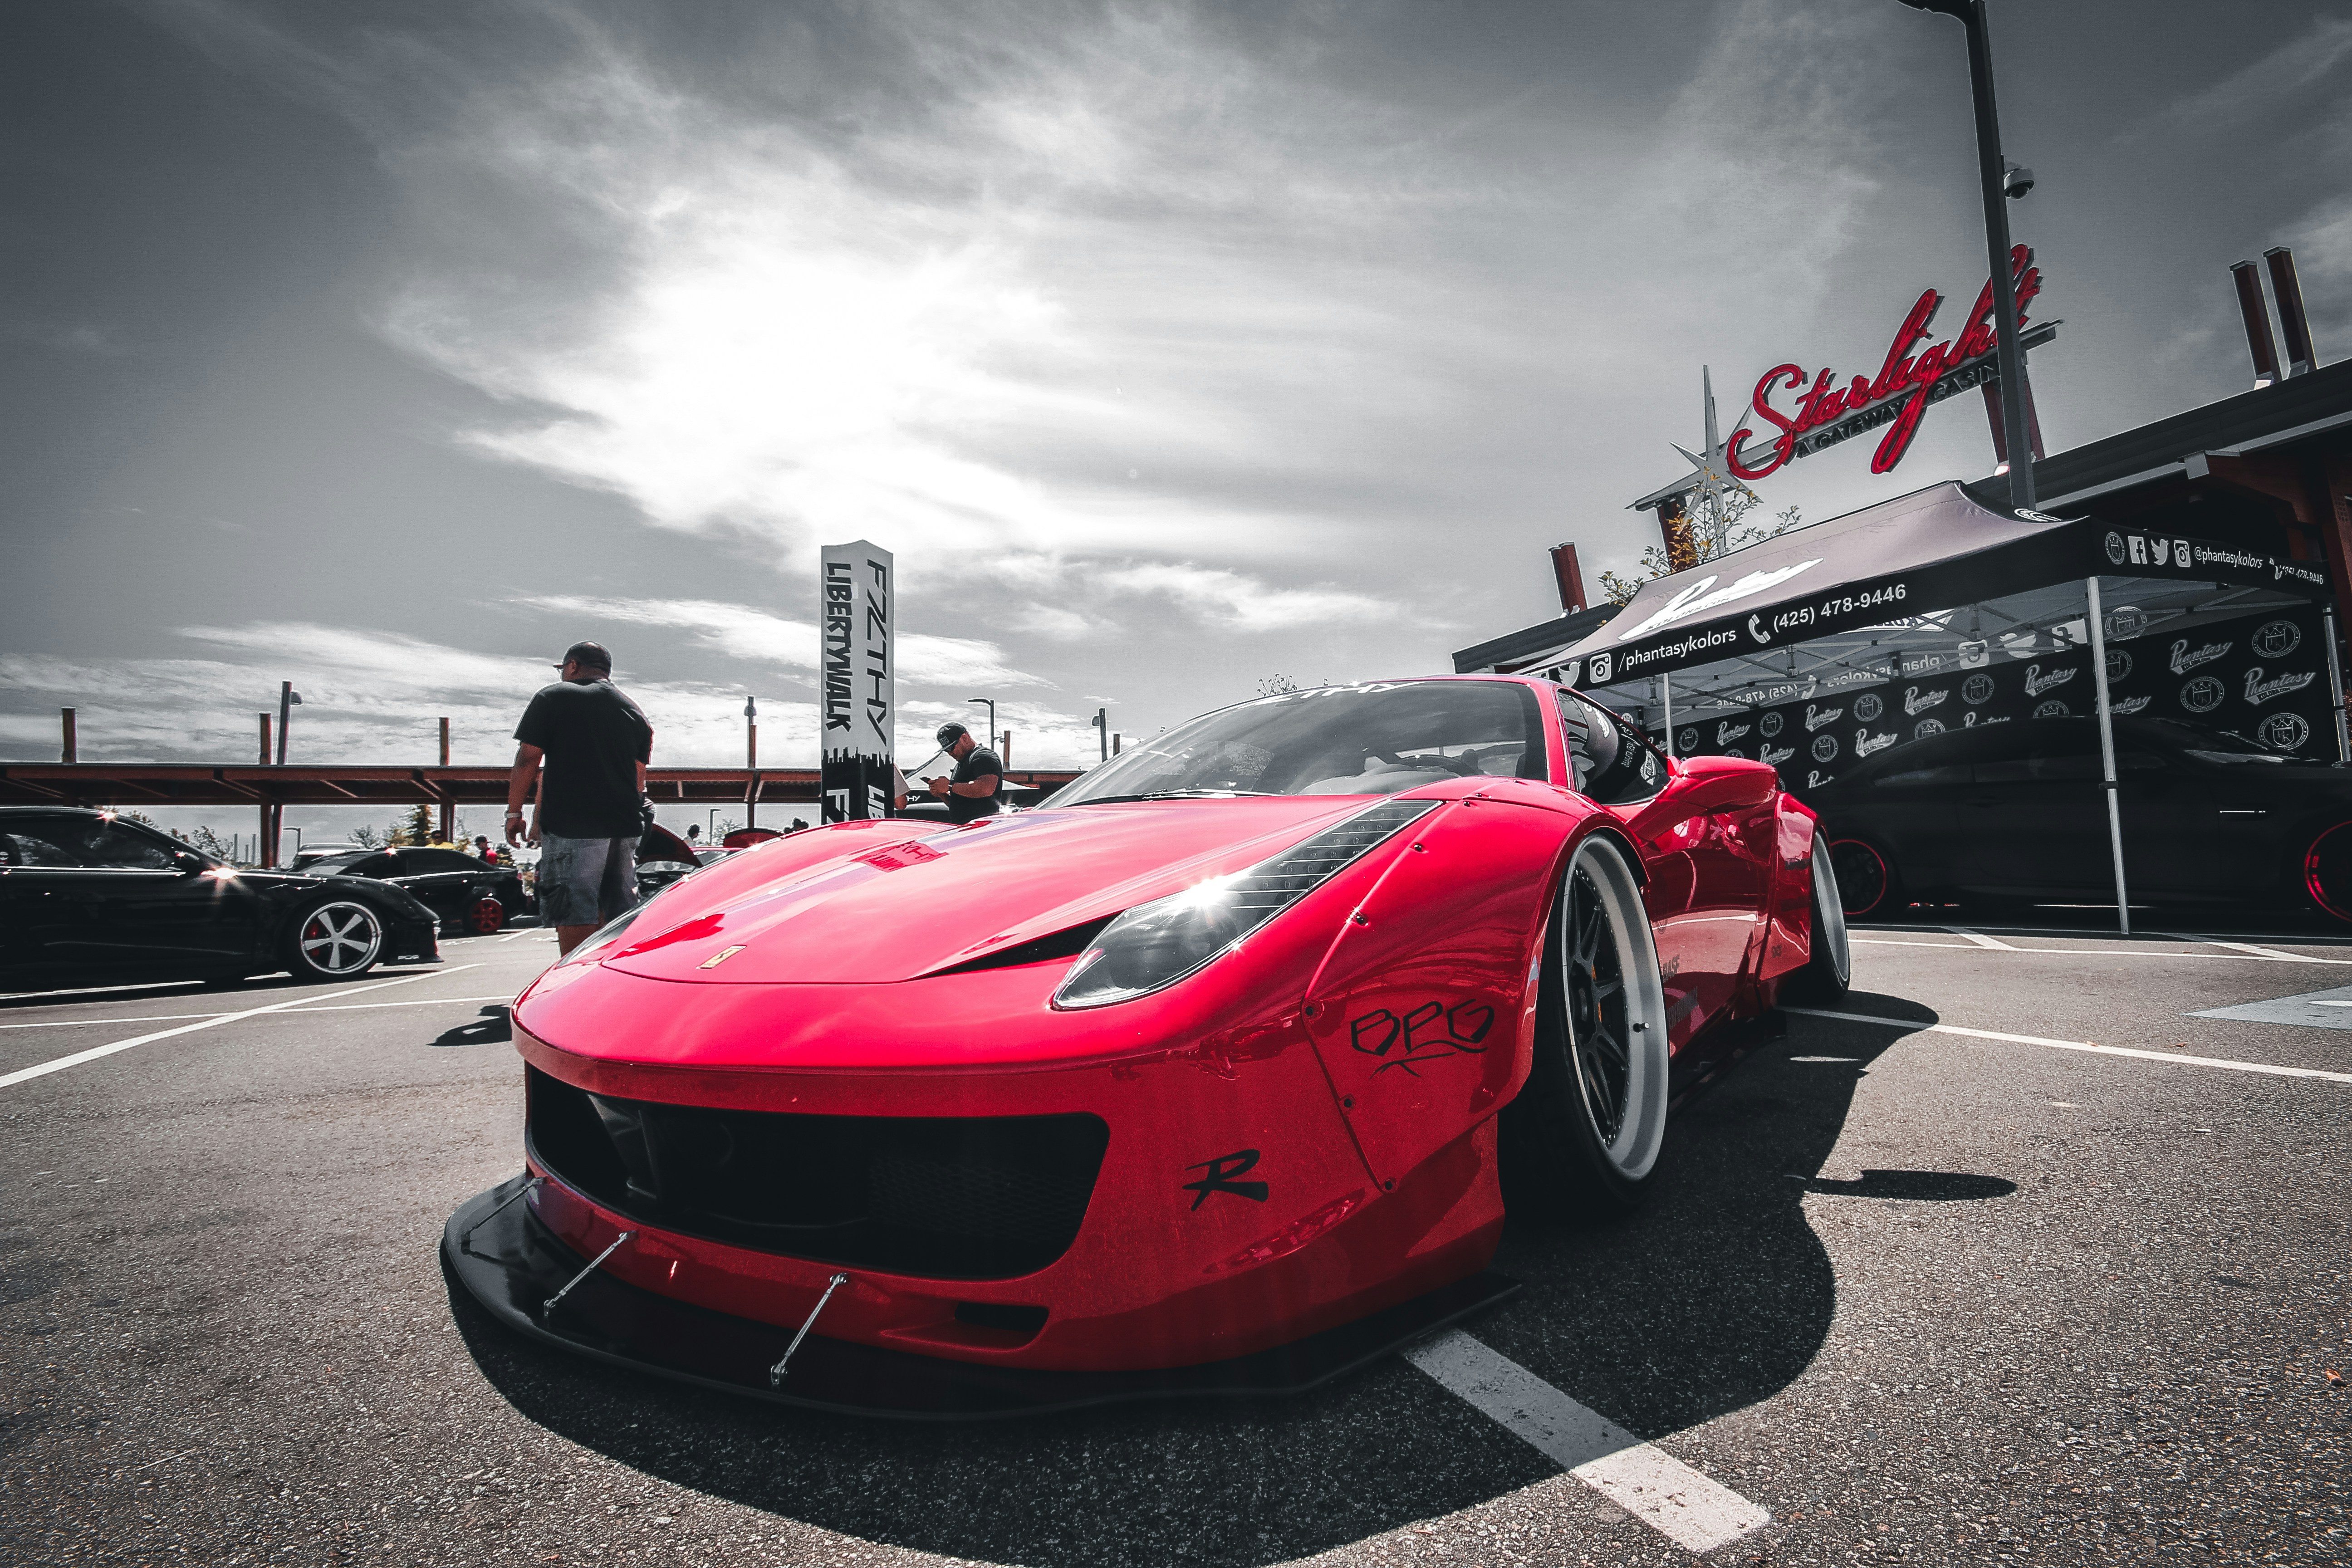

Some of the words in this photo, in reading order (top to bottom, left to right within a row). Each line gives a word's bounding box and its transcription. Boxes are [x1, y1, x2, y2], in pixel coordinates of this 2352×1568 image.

[1727, 243, 2042, 480] Starlight
[1929, 364, 2000, 400] CASIN
[2194, 547, 2263, 568] @phantasykolors
[1618, 630, 1737, 672] /phantasykolors
[1774, 606, 1815, 632] (425)
[1821, 583, 1906, 617] 478-9446
[826, 563, 853, 732] LIBERTYWALK
[867, 559, 887, 746] FZTHY
[2170, 639, 2234, 669] Phantasy
[2025, 664, 2078, 691] Phantasy
[2244, 667, 2316, 698] Phantasy
[1905, 686, 1949, 711] Phantasy
[1805, 705, 1843, 727] Phantasy
[1717, 721, 1750, 743] Phantasy
[1856, 728, 1898, 752] Phantasy
[1760, 743, 1795, 764] Phantasy
[1182, 1149, 1269, 1212] R
